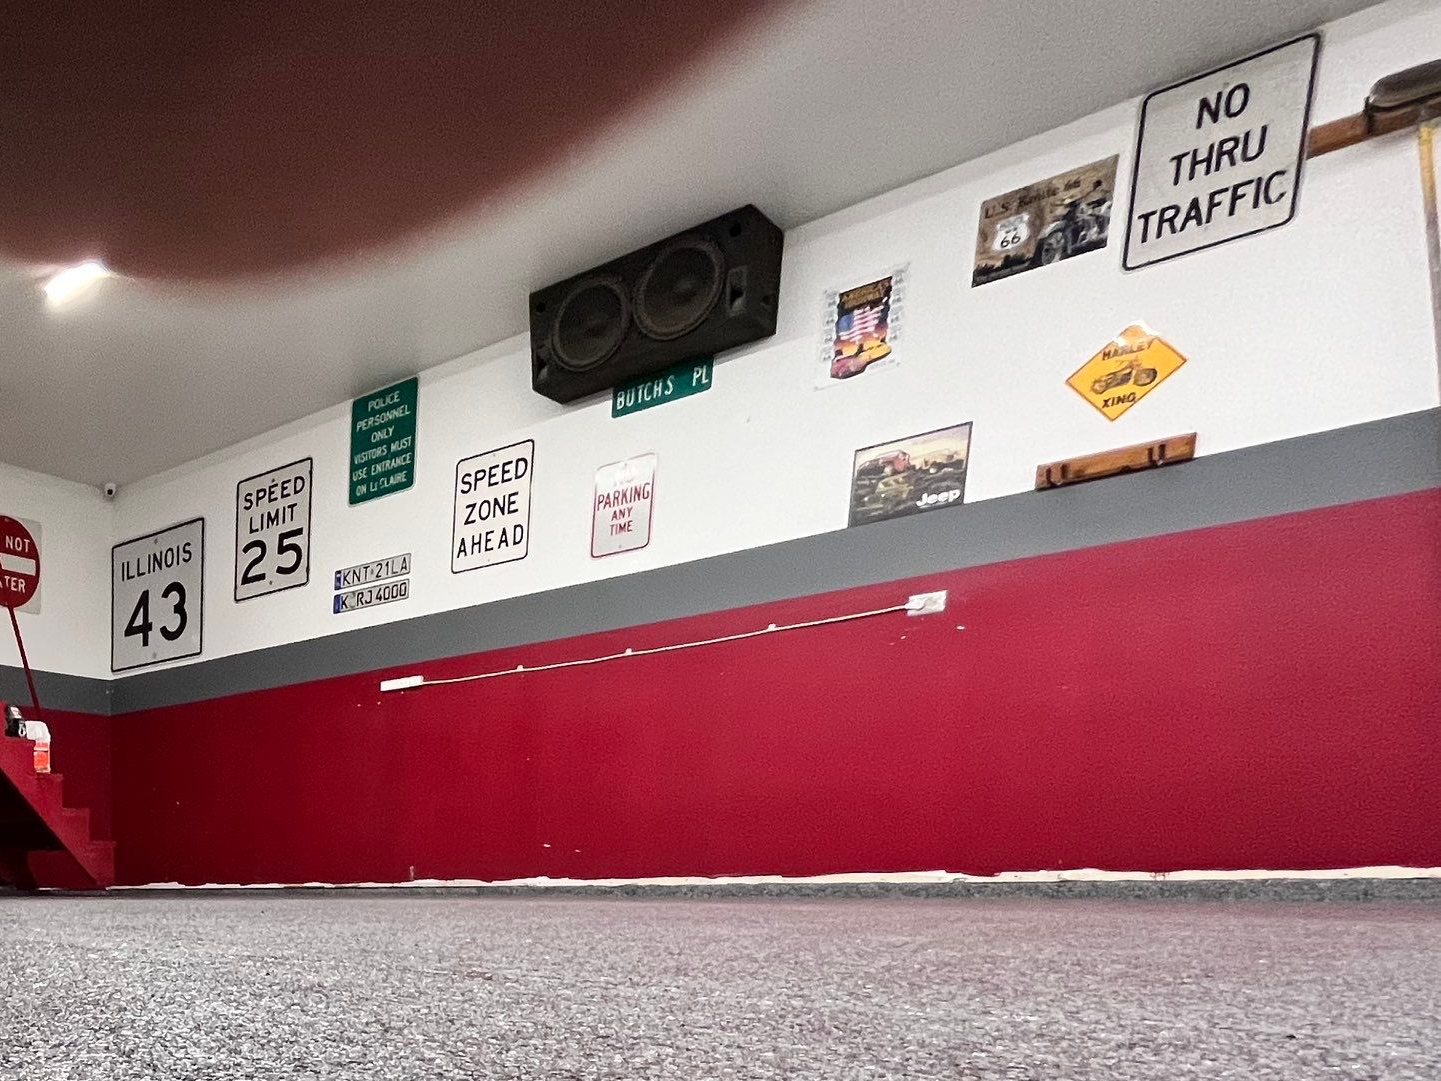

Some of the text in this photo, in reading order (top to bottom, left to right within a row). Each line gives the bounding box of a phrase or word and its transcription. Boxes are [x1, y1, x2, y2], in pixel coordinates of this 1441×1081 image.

[1196, 82, 1250, 130] NO
[1169, 124, 1268, 186] THRU
[1137, 169, 1288, 244] TRAFFIC
[1000, 233, 1021, 248] 66
[692, 365, 709, 387] PL
[368, 391, 400, 412] POLICE
[1102, 392, 1136, 408] XING
[356, 404, 411, 432] PERSONNEL
[371, 425, 395, 443] ONLY
[354, 436, 412, 465] VISITORS MUST
[352, 452, 412, 482] USE ENTRANCE
[460, 457, 528, 494] SPEED
[243, 475, 305, 511] SPEED
[356, 484, 367, 496] ON
[597, 482, 651, 511] PARKING
[916, 489, 961, 507] Jeep
[249, 502, 298, 534] LIMIT
[463, 491, 519, 525] ZONE
[611, 506, 633, 521] ANY
[456, 523, 524, 559] AHEAD
[610, 520, 633, 536] TIME
[5, 535, 30, 553] NOT
[241, 527, 304, 586] 25
[121, 542, 192, 582] ILLINOIS
[342, 557, 408, 586] KNT 21LA
[124, 581, 188, 647] 43
[340, 595, 349, 609] K
